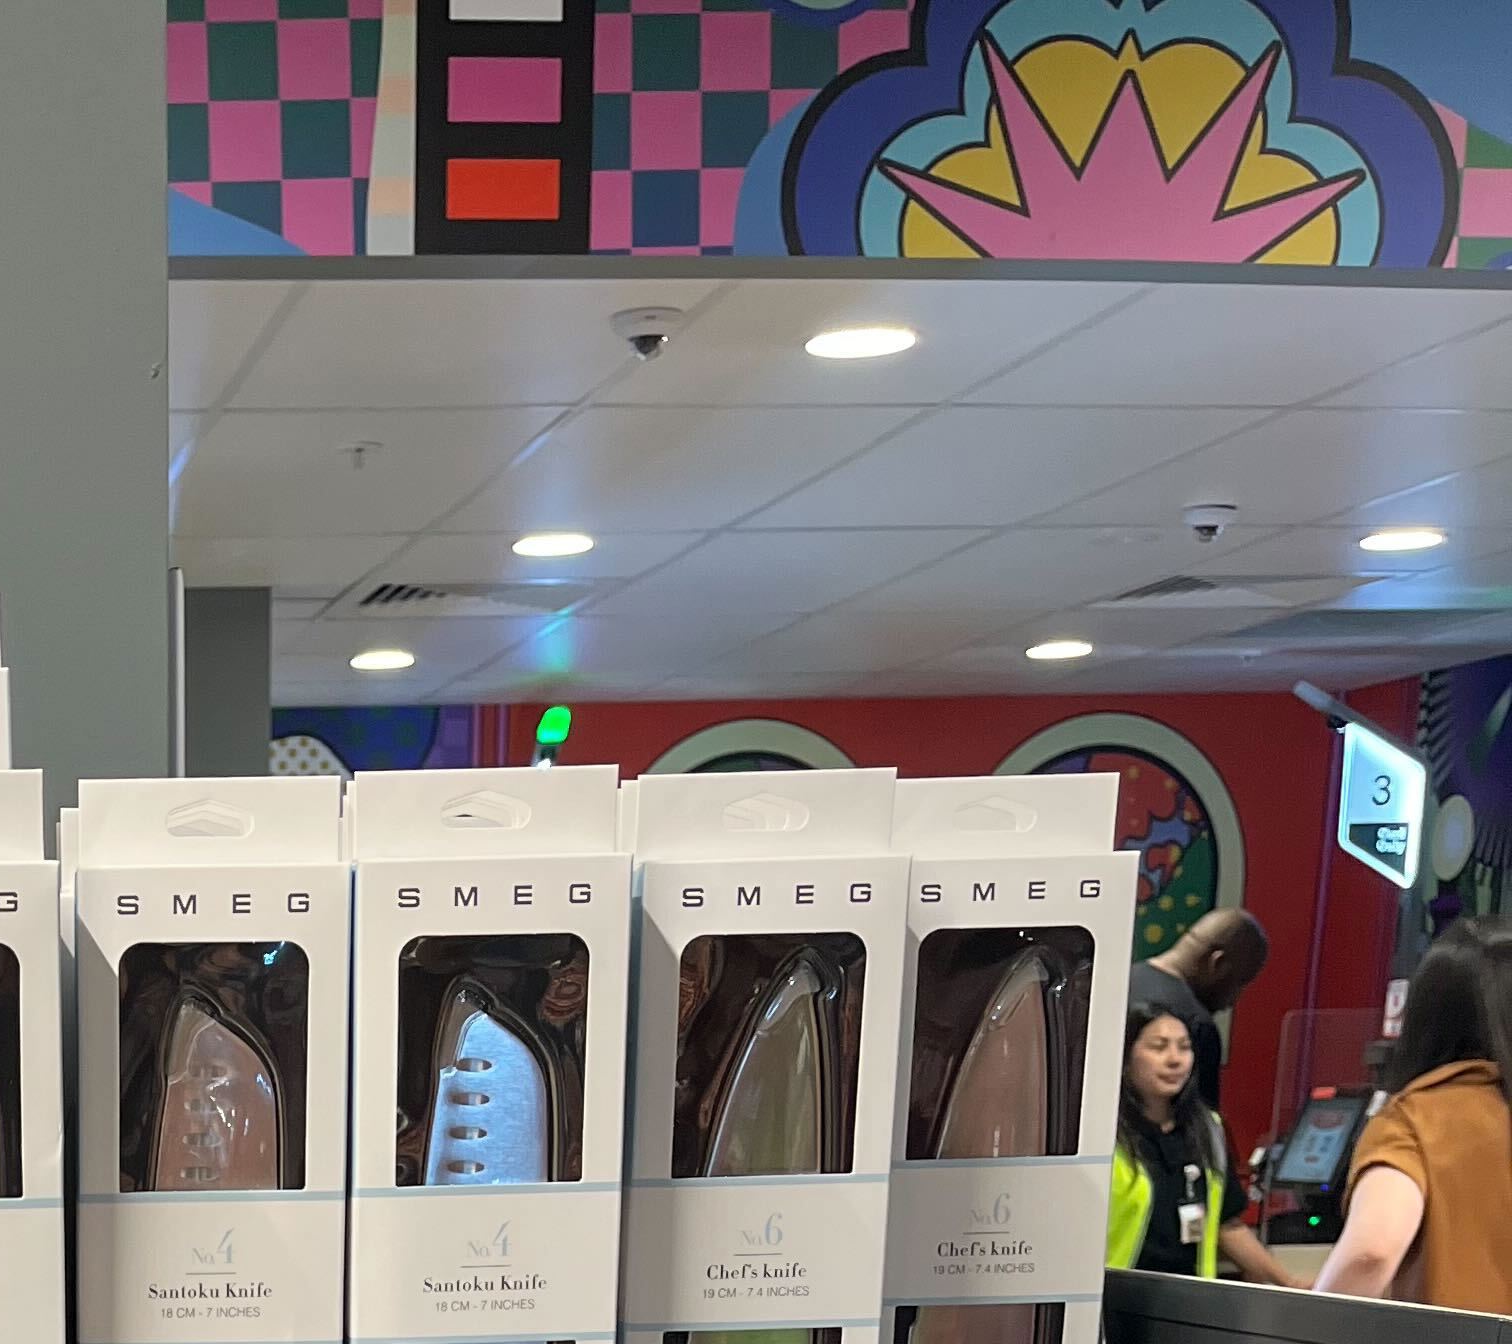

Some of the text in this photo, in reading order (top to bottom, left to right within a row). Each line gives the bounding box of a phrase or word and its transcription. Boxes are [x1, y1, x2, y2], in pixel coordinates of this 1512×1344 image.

[1372, 775, 1391, 806] 3
[398, 883, 592, 908] SMEG
[682, 883, 872, 907] SMEG
[920, 880, 1100, 903] SMEG
[117, 893, 310, 915] SMEG
[937, 1239, 1033, 1258] Chef's knife
[706, 1262, 807, 1281] Chef's knife
[148, 1282, 273, 1300] Santoku Knife
[422, 1274, 548, 1294] Santoku Knife
[703, 1287, 715, 1299] 19
[718, 1287, 737, 1299] CM
[766, 1285, 810, 1298] INCHES
